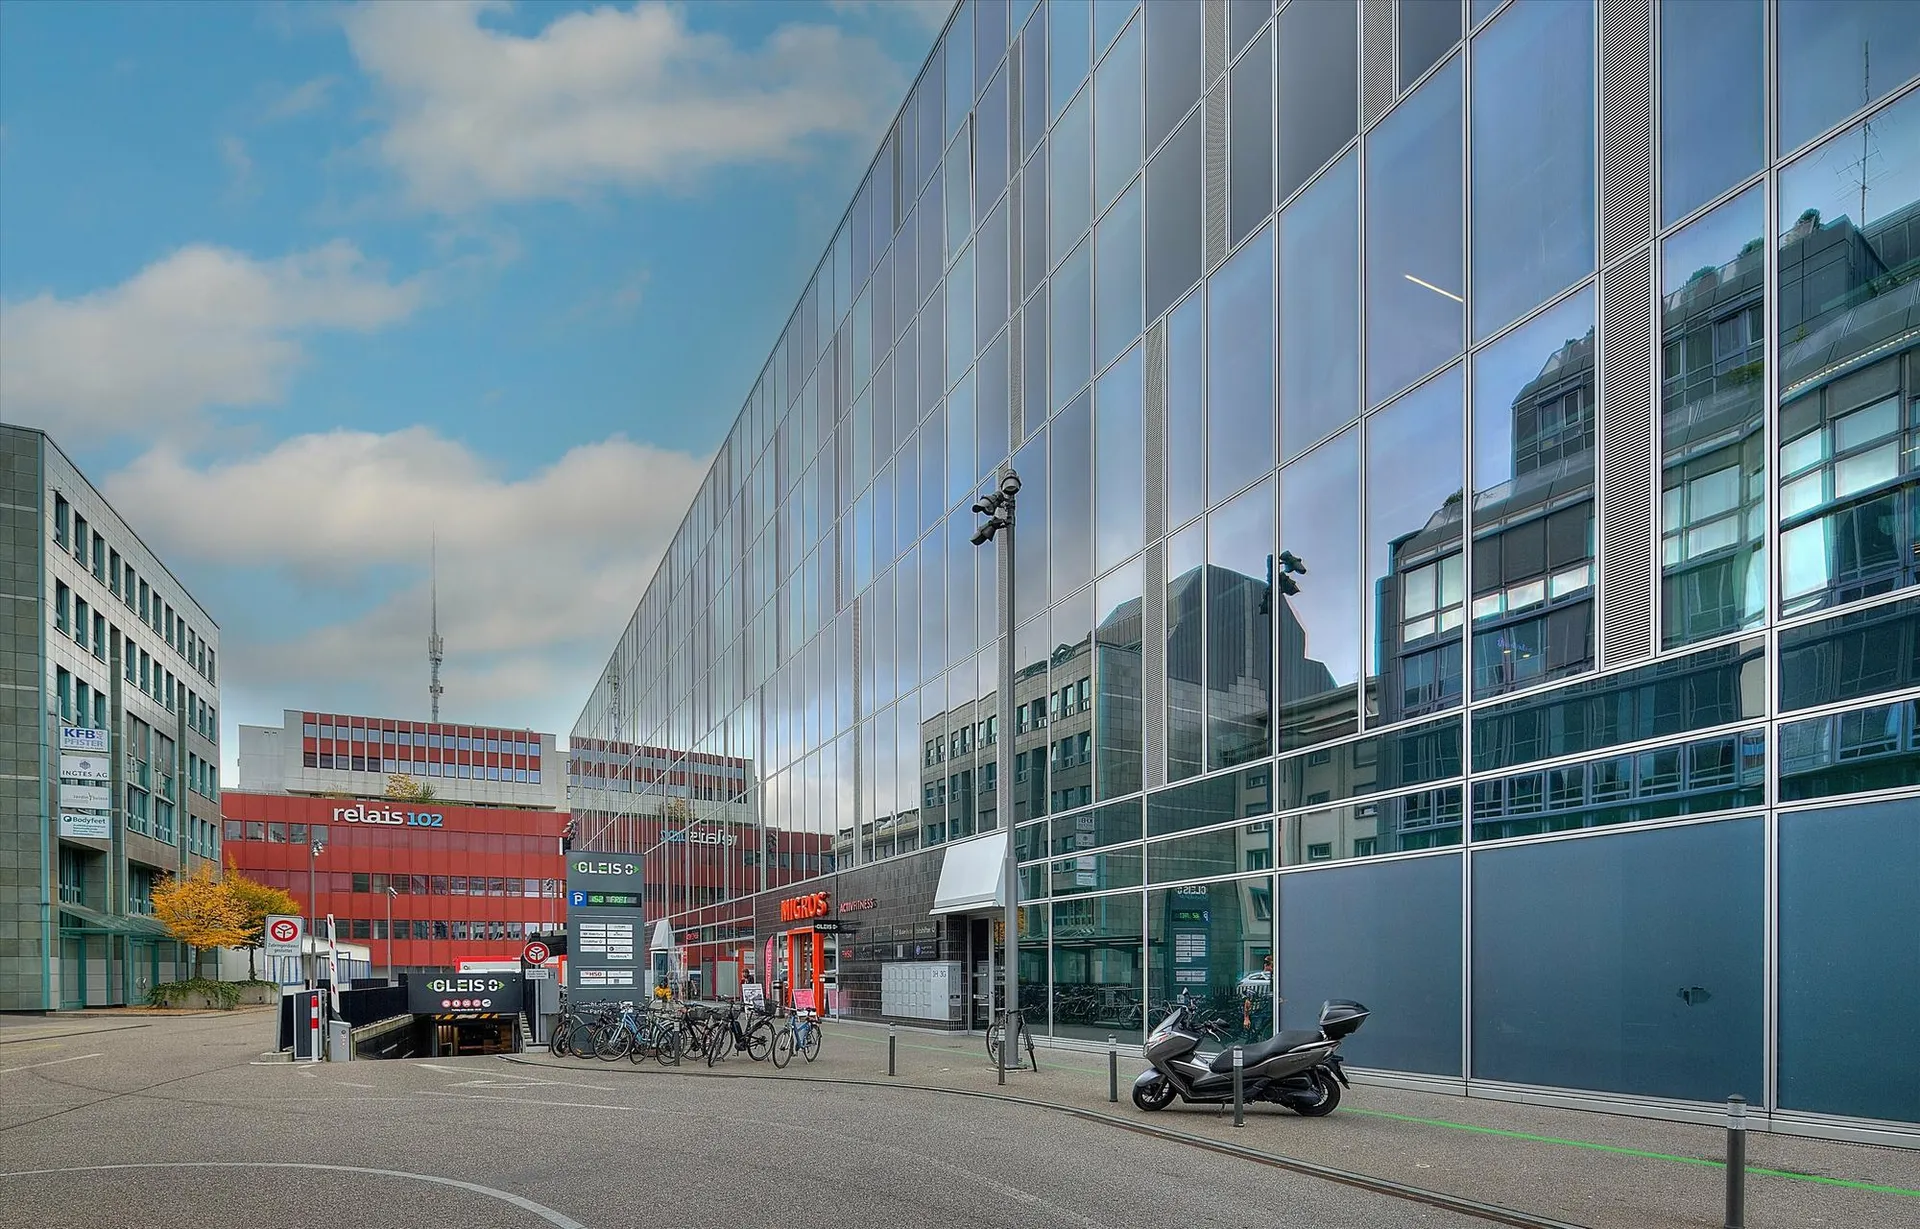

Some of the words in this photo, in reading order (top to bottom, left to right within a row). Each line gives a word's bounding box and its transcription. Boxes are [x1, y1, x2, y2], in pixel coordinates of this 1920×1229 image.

[64, 728, 95, 739] KFB
[64, 738, 103, 747] PFISTER
[72, 816, 106, 825] Bodyfeet
[333, 804, 404, 825] relais
[407, 812, 444, 827] 102
[577, 861, 622, 875] GLEIS
[624, 863, 634, 875] 0
[574, 894, 584, 905] P
[780, 891, 828, 922] MIGROS
[433, 979, 485, 992] GLEIS
[488, 979, 498, 992] 0
